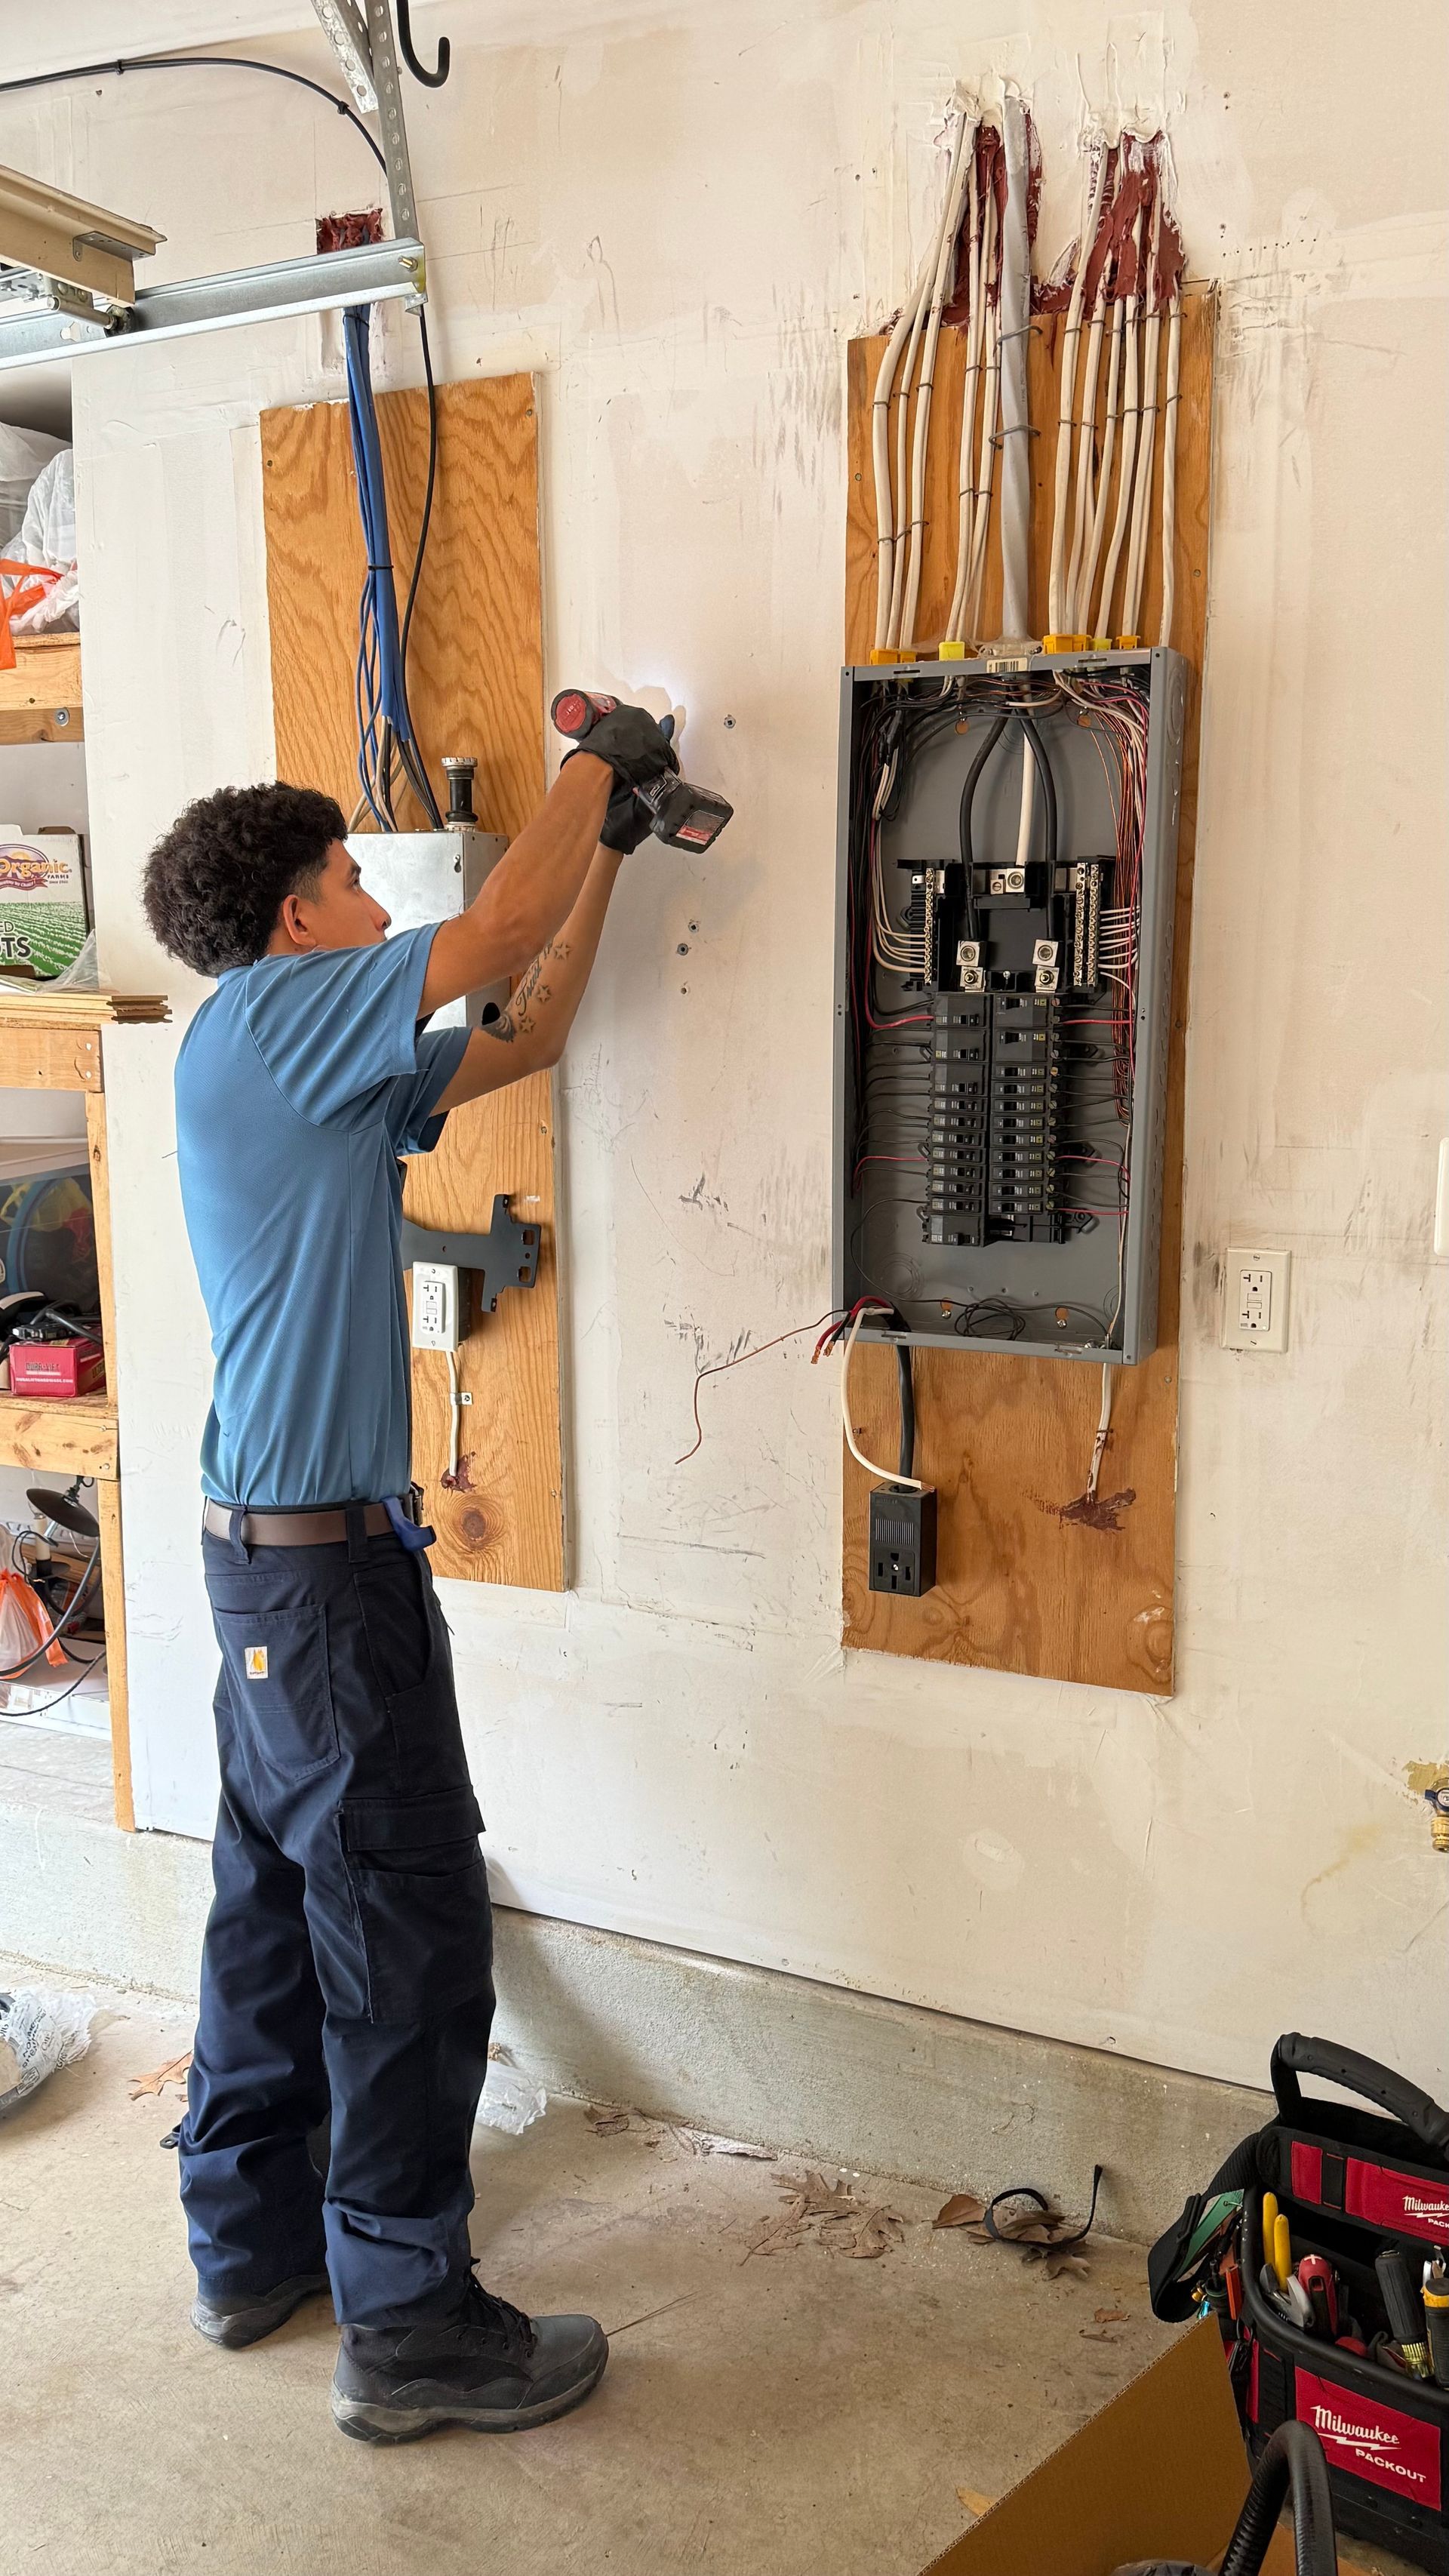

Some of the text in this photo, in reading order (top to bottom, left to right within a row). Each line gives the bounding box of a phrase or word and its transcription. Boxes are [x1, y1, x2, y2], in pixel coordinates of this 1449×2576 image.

[0, 859, 69, 878] Organic
[0, 937, 31, 958] TS
[1309, 2405, 1400, 2444] Milwaukee
[1355, 2448, 1426, 2483] PACKOUT
